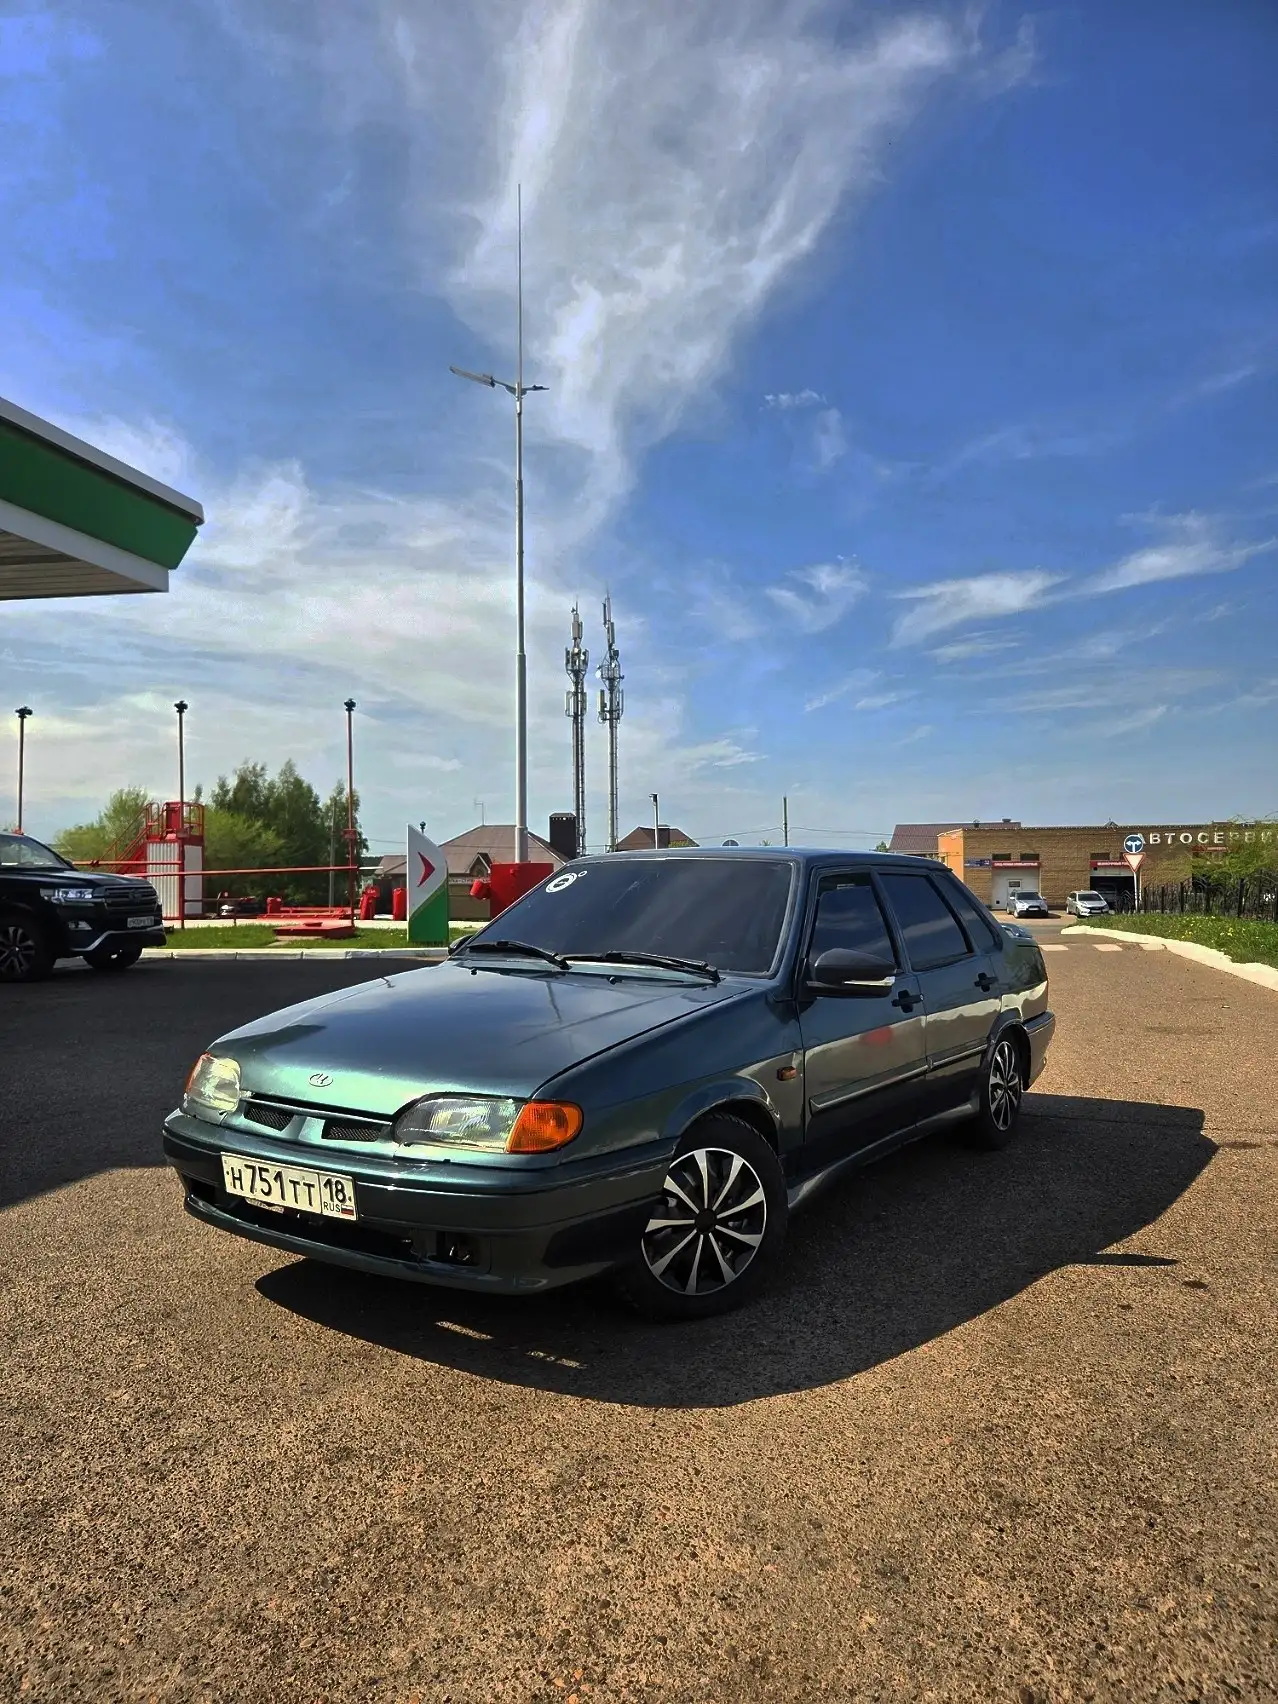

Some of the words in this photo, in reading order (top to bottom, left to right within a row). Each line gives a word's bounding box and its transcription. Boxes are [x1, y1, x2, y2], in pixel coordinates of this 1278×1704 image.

[230, 1163, 315, 1207] Н751ТТ
[323, 1177, 347, 1203] 18
[323, 1201, 341, 1213] RUS
